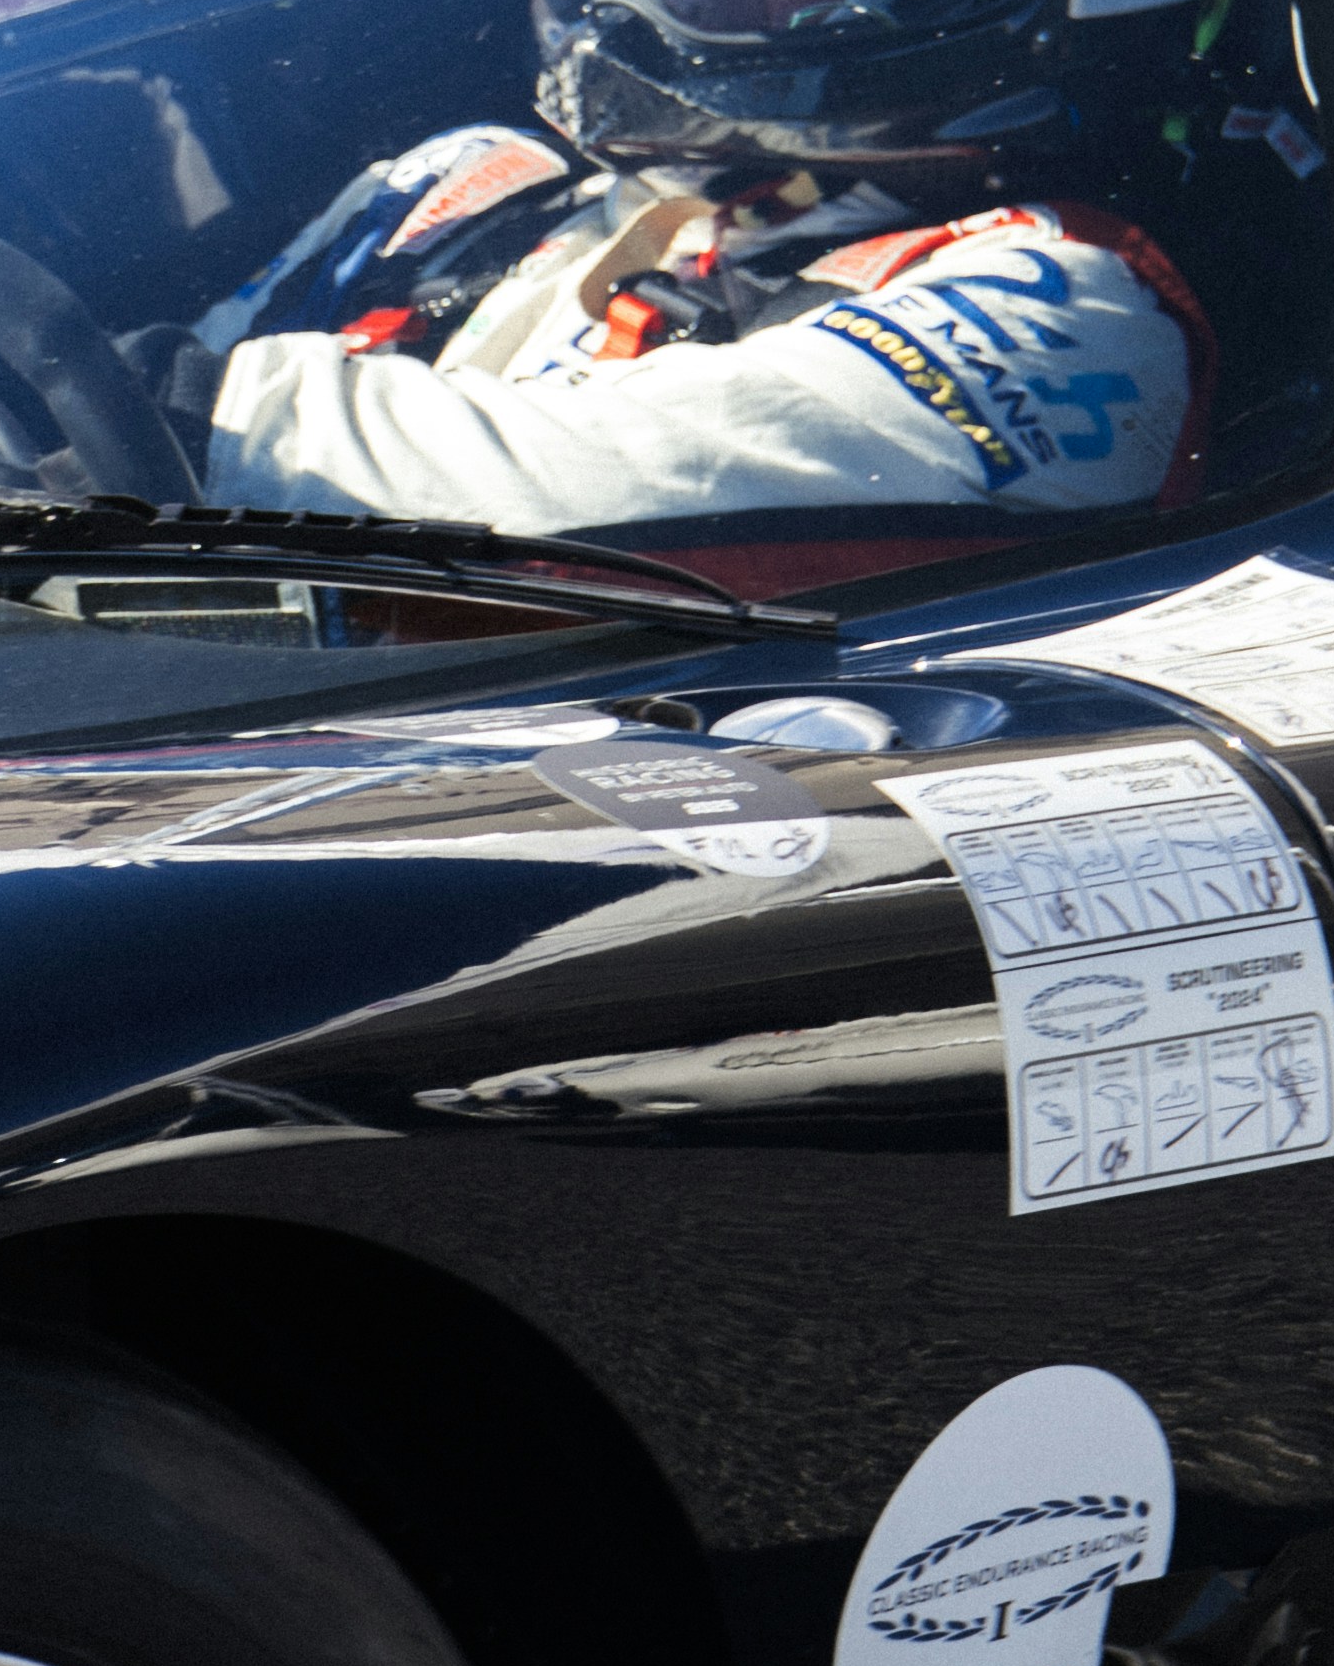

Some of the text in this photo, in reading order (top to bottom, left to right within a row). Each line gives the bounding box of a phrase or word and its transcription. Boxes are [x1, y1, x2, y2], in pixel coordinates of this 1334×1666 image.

[867, 1524, 1150, 1617] CLASSIC ENDURANCE RACING
